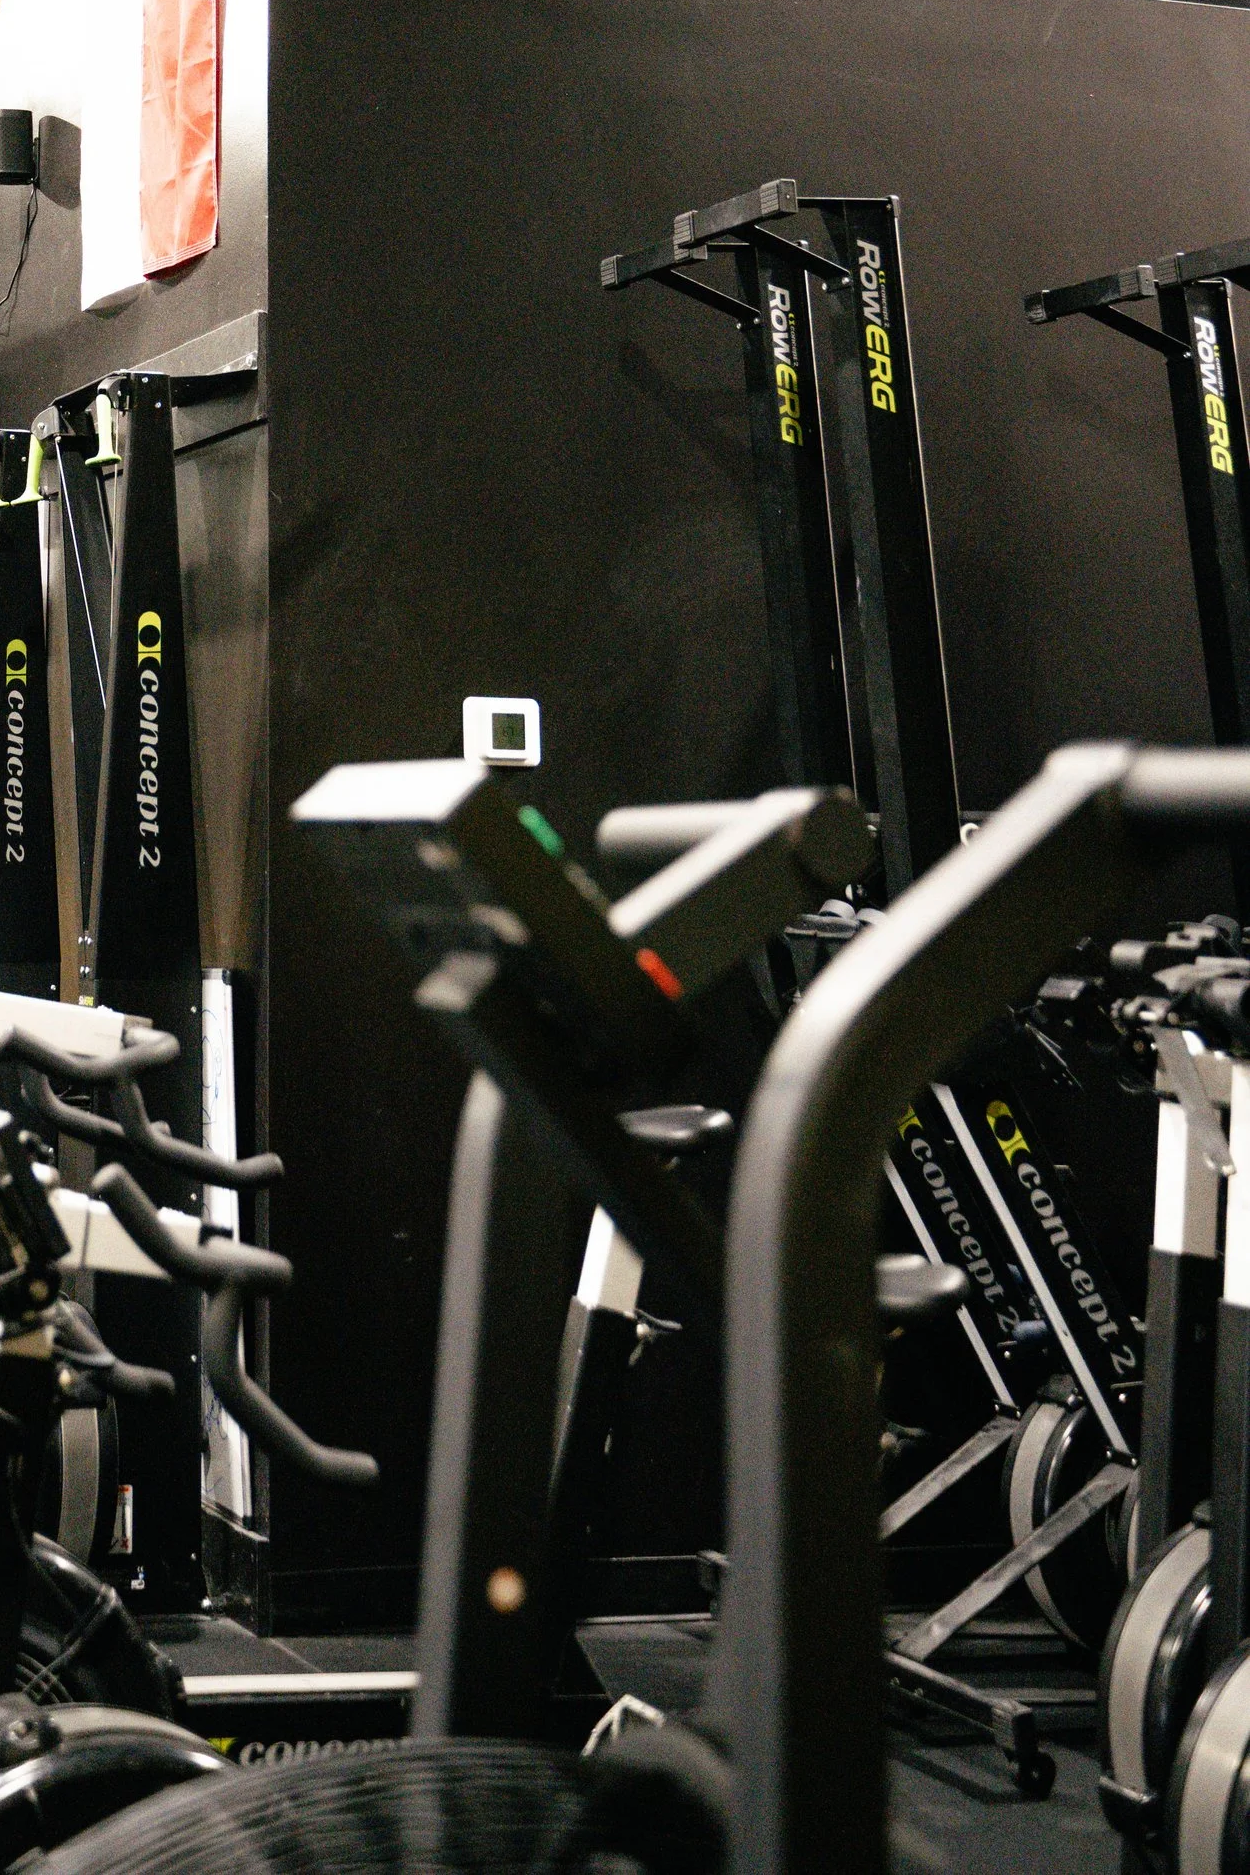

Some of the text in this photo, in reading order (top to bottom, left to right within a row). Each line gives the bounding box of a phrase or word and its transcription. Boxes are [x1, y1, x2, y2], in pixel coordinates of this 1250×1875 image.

[4, 689, 25, 863] concept 2
[136, 669, 161, 867] concept 2
[911, 1138, 1004, 1304] concept
[1017, 1162, 1136, 1375] concept 2
